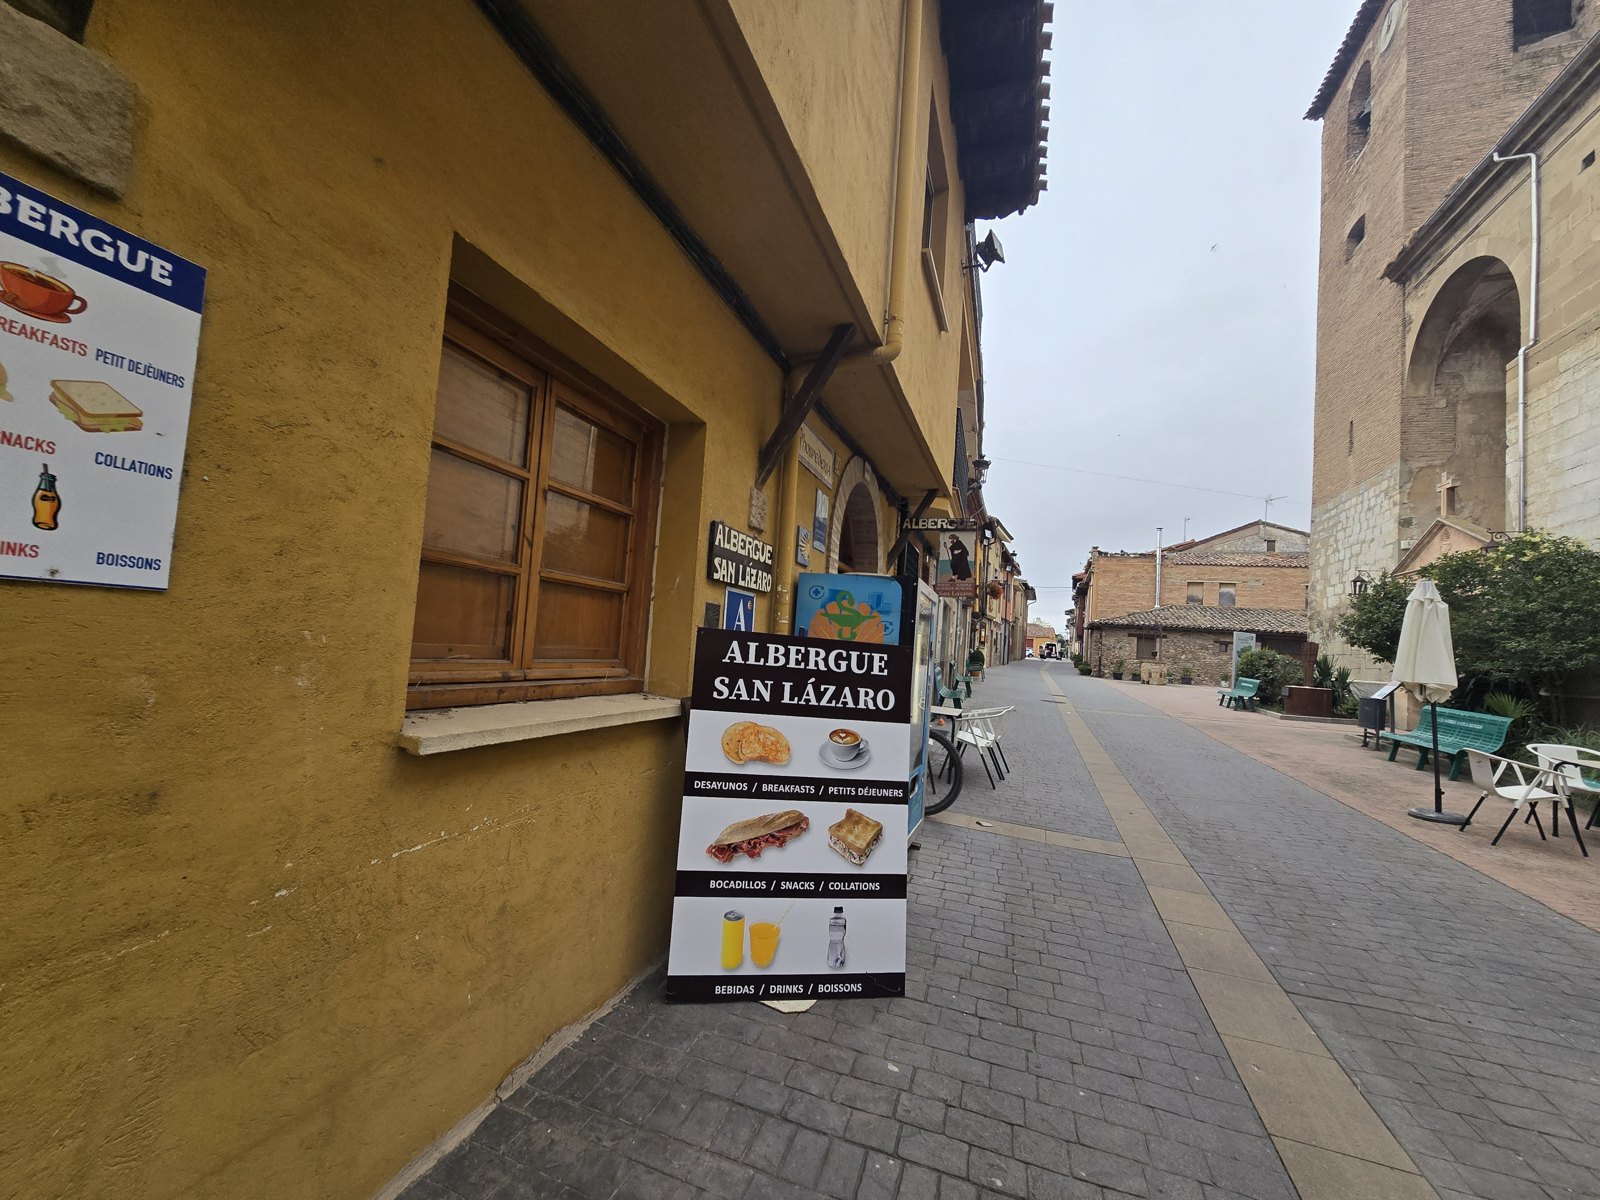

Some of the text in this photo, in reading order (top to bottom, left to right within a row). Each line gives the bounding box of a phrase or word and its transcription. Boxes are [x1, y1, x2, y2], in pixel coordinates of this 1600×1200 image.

[0, 316, 88, 357] REAKFASTS
[95, 348, 127, 369] PETIT
[0, 430, 56, 455] NACKS
[95, 452, 173, 480] COLLATIONS
[902, 518, 977, 529] ALBERGUE
[0, 541, 40, 558] INKS
[714, 524, 773, 565] ALBERGUE
[96, 552, 162, 571] BOISSONS
[713, 557, 772, 593] SAN LÁZARO
[733, 599, 746, 631] A
[722, 640, 889, 676] ALBERGUE
[712, 676, 896, 711] SAN LÁZARO
[694, 780, 748, 791] DESAYUNOS
[762, 783, 815, 794] BREAKFASTS
[828, 786, 856, 796] PETITS
[857, 785, 903, 798] DÉJEUNERS
[709, 880, 766, 890] BOCADILLOS
[780, 881, 815, 891] SNACKS
[828, 881, 880, 891] COLLATIONS
[714, 985, 755, 995] BEBIDAS
[769, 984, 804, 994] DRINKS
[818, 983, 862, 993] BOISSONS
